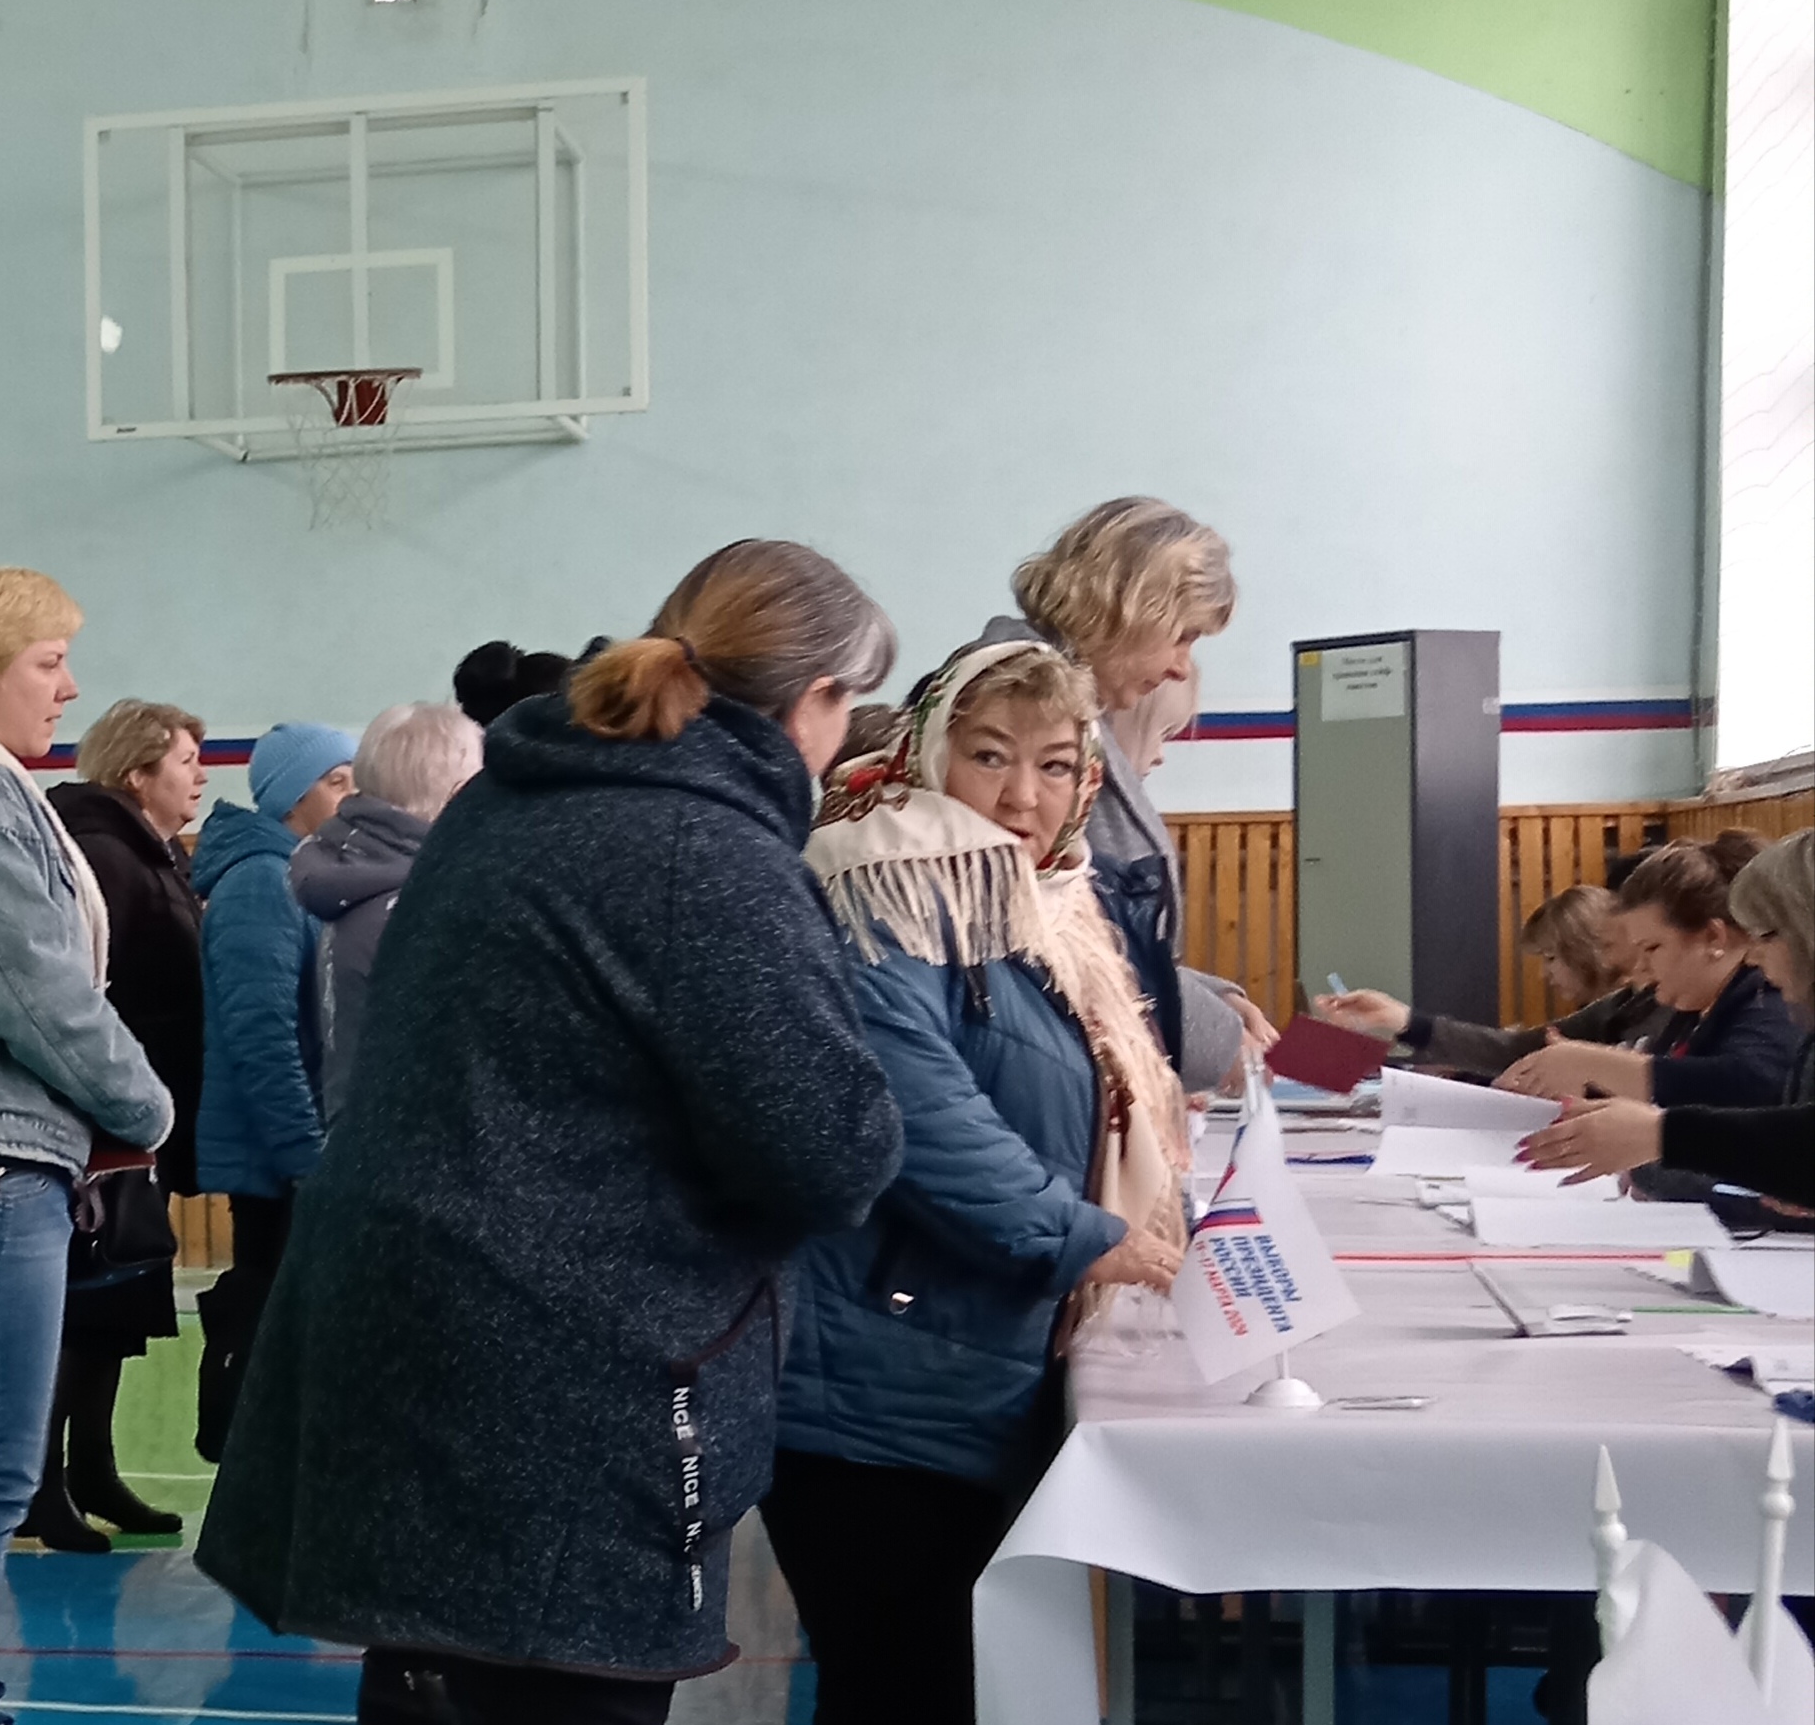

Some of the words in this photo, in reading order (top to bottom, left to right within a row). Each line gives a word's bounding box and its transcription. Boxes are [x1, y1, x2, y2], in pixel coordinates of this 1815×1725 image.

[1209, 1237, 1252, 1298] РОССИИ
[1230, 1236, 1294, 1333] ПРЕЗИДЕНТА
[1253, 1235, 1302, 1301] ВЫБОРЫ
[672, 1386, 694, 1441] NICE
[681, 1455, 700, 1509] NICE
